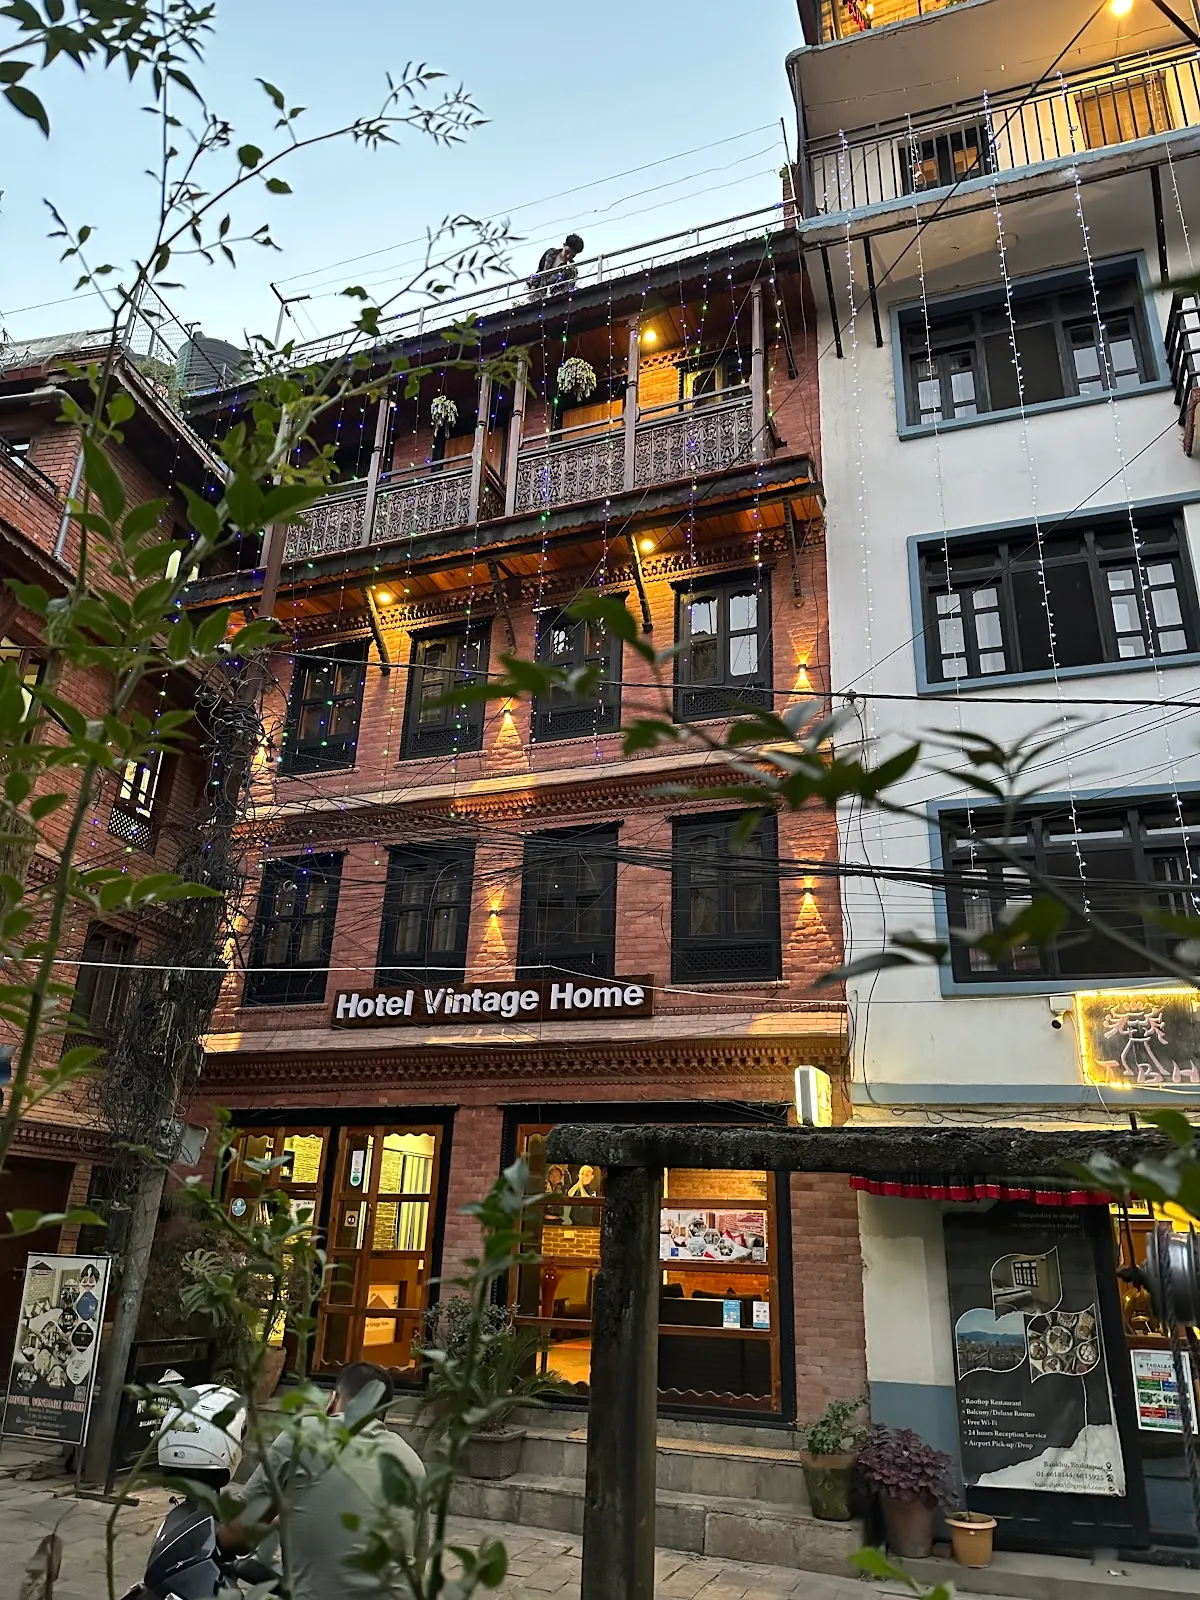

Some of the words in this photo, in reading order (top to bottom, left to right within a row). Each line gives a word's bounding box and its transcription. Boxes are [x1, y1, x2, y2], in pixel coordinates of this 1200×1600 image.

[336, 989, 415, 1019] Hotel
[424, 987, 540, 1018] Vintage
[549, 982, 645, 1010] Home
[965, 1398, 989, 1406] Rooftop
[990, 1398, 1022, 1407] Restaurant
[966, 1408, 1013, 1417] Balcony/Deluxe
[994, 1430, 1024, 1439] Reception
[991, 1440, 1034, 1450] Pick-up/Drop
